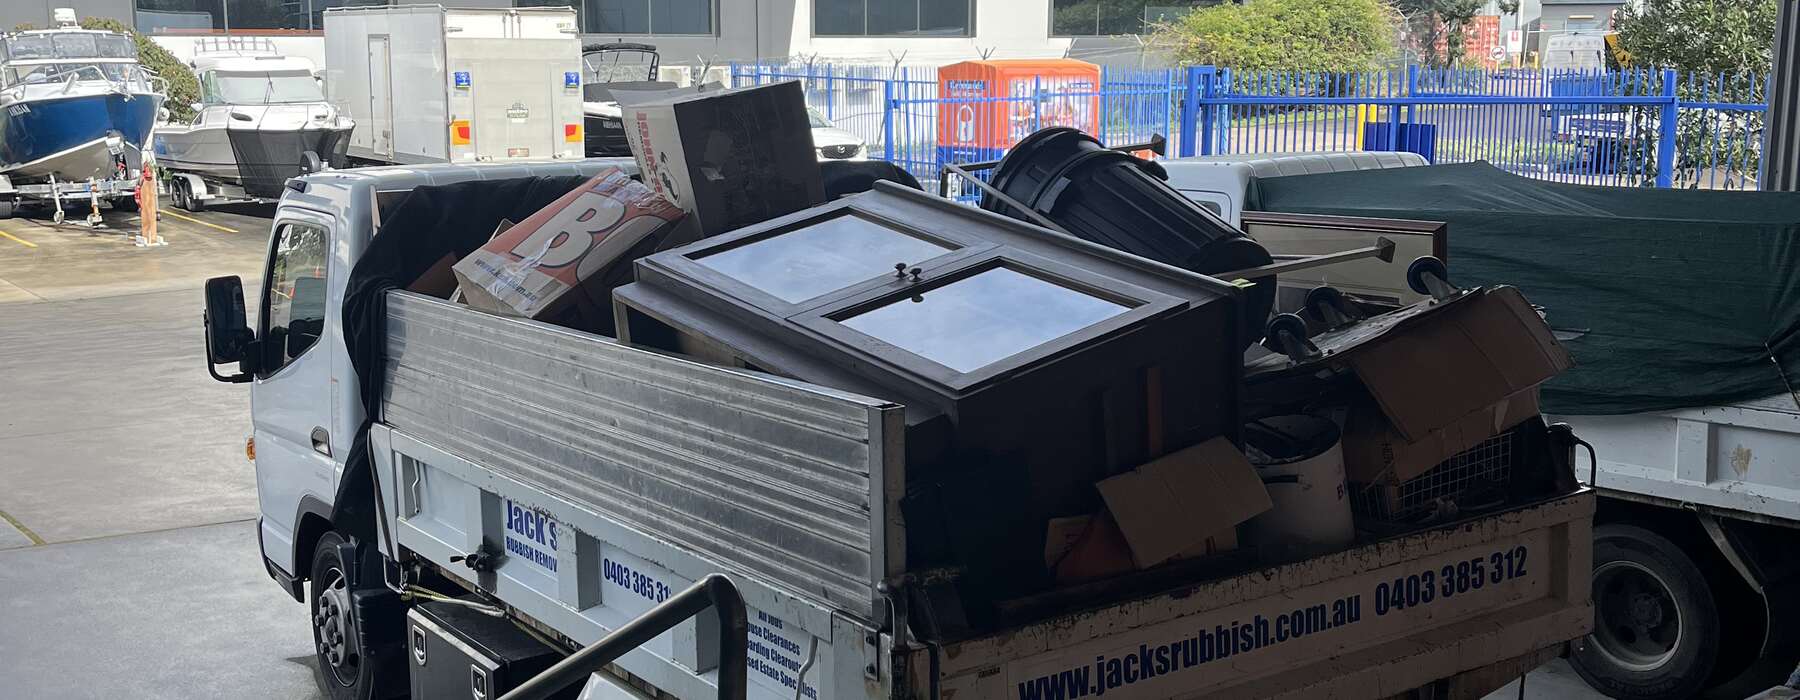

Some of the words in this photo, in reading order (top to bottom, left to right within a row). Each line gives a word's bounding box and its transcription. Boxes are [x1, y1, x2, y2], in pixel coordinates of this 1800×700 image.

[507, 500, 558, 551] Jack's
[506, 536, 534, 561] RUBBISH
[603, 558, 630, 590] 0403
[633, 571, 654, 600] 385
[656, 581, 672, 603] 31
[763, 627, 800, 656] Clearances
[1018, 594, 1361, 700] www.jacksrubbish.com.au
[1375, 575, 1435, 616] 0403
[1441, 560, 1485, 598] 385
[1491, 546, 1528, 584] 312
[760, 659, 780, 681] Estate
[780, 670, 817, 700] Speclists
